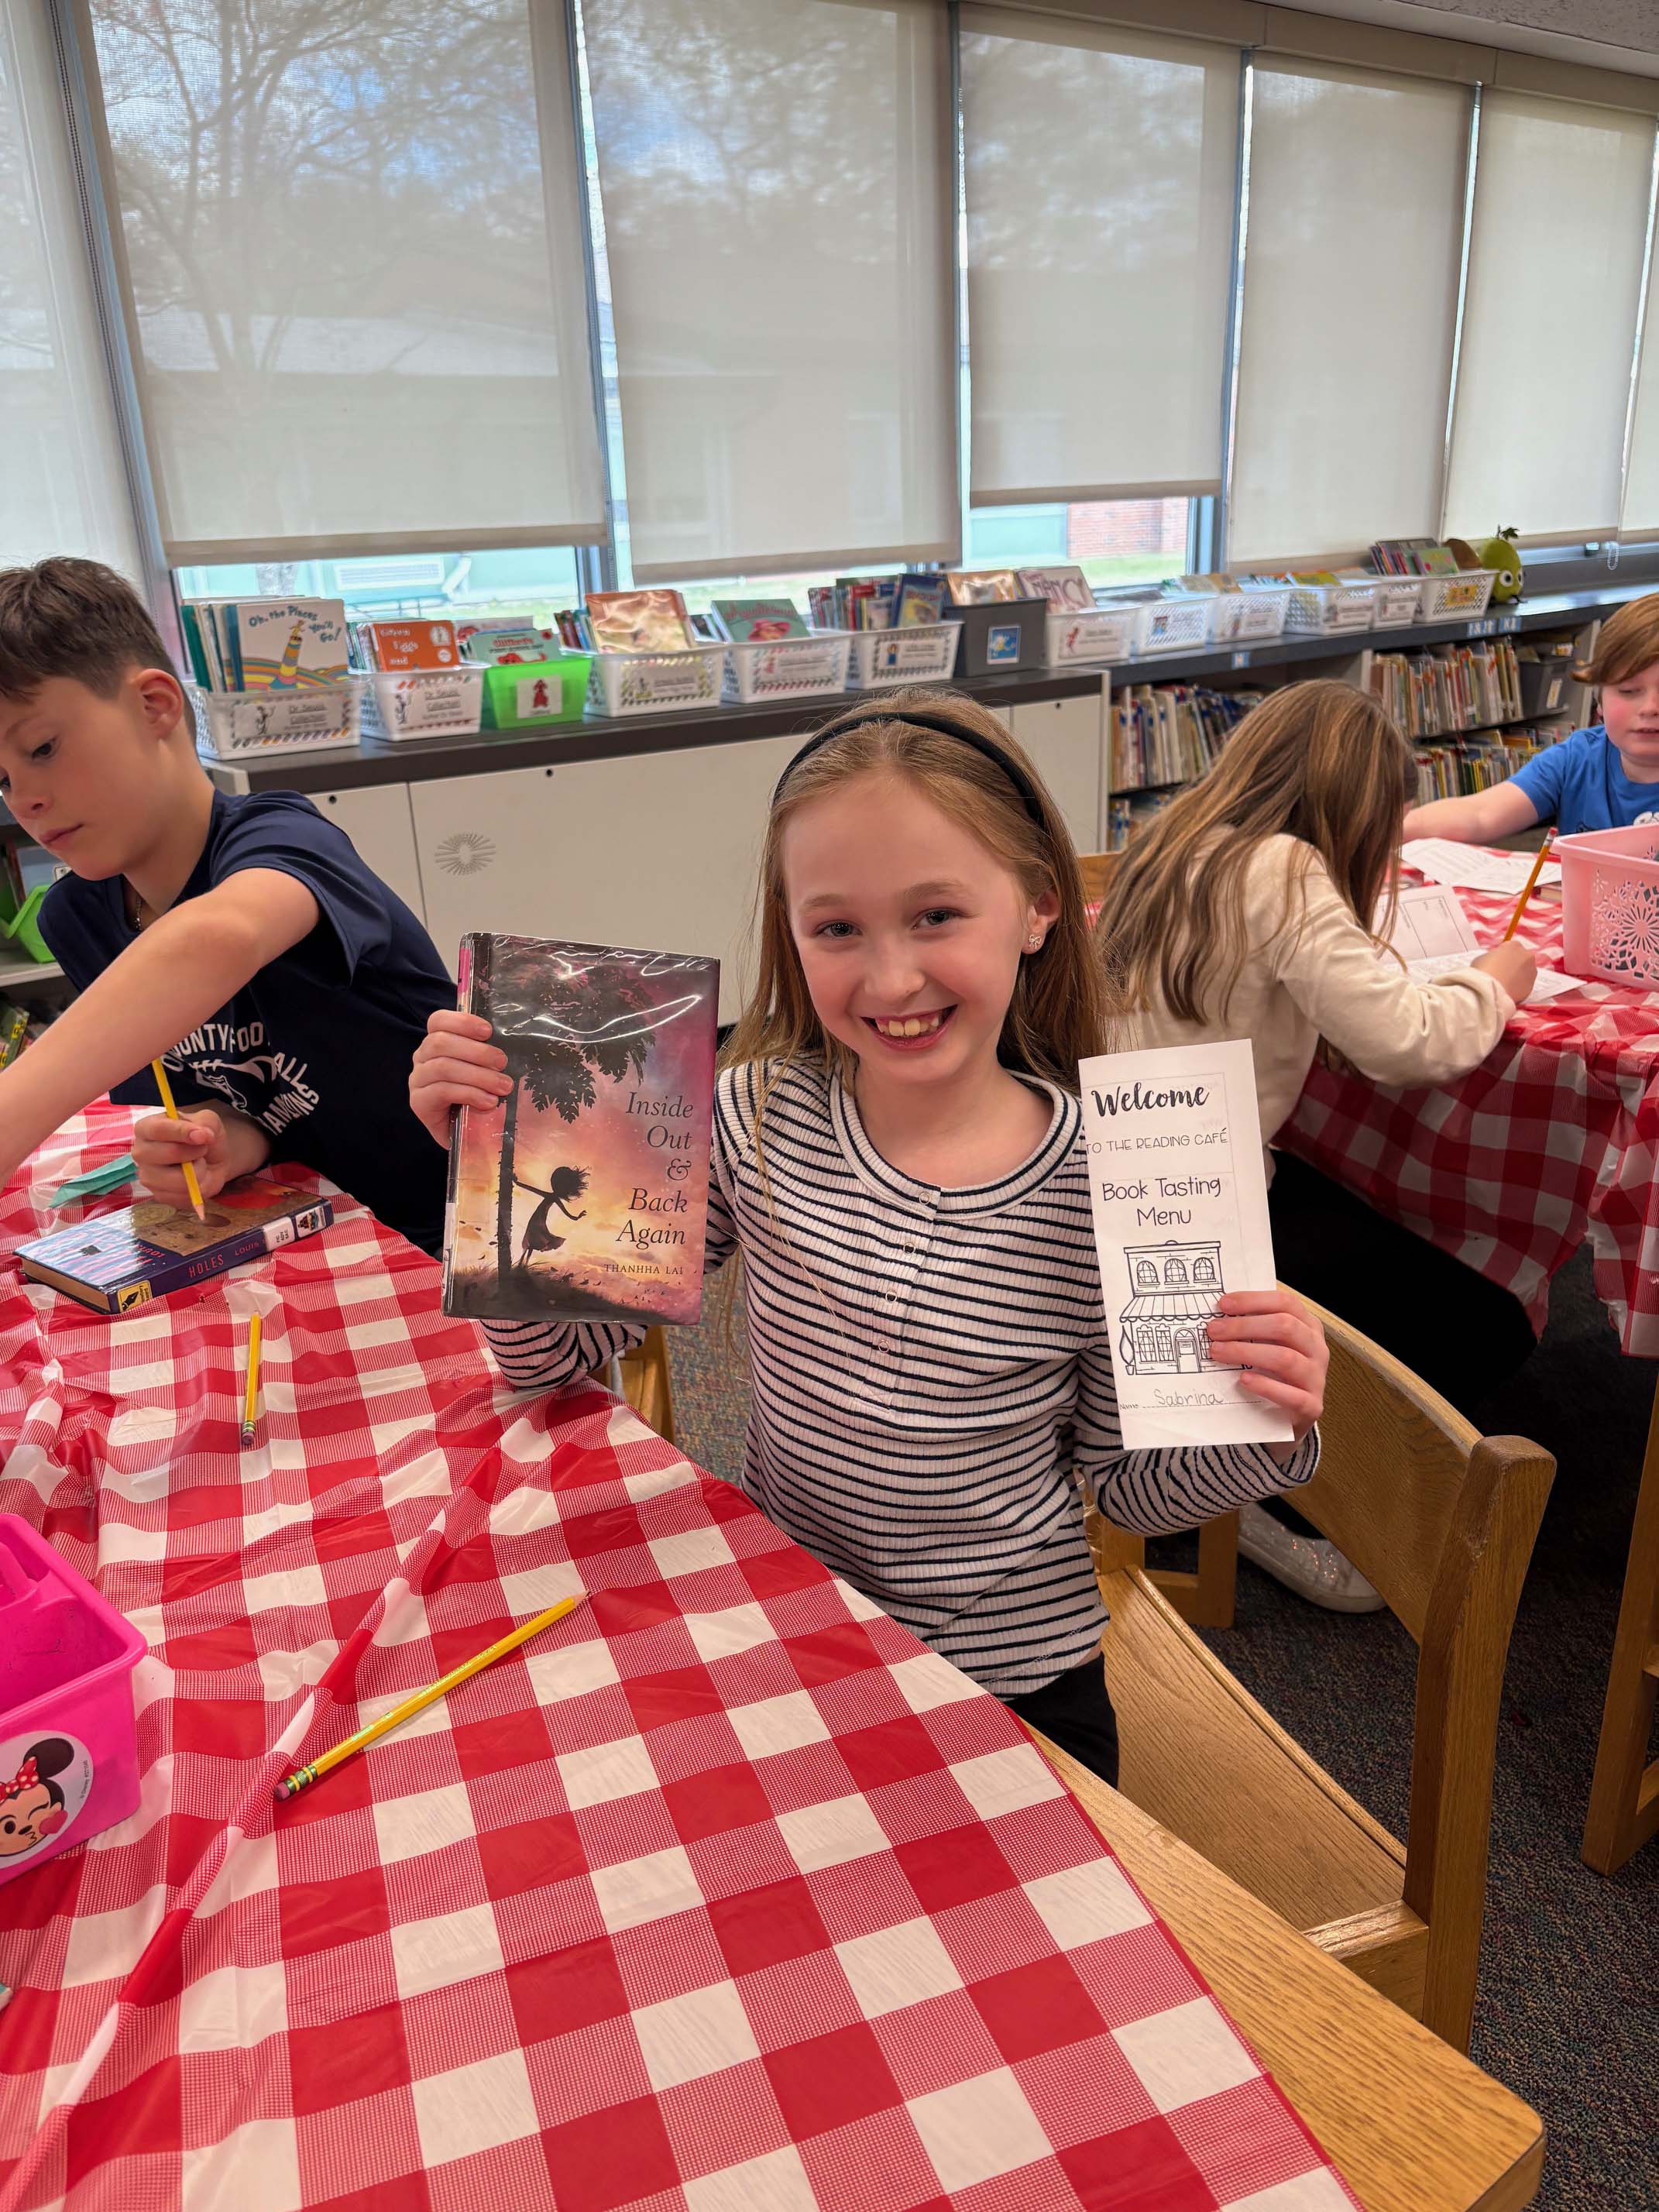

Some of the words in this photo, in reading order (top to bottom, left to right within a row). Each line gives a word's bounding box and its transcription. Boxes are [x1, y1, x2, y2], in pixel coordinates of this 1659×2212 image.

[287, 606, 318, 621] Places
[320, 627, 342, 643] Go!
[625, 1091, 694, 1118] Inside
[1091, 1082, 1210, 1117] Welcome
[647, 1125, 693, 1150] Out
[1086, 1142, 1102, 1155] TO
[1106, 1139, 1133, 1152] THE
[1136, 1135, 1190, 1149] READING
[1194, 1127, 1228, 1146] CAFÉ
[667, 1158, 692, 1181] &
[628, 1187, 688, 1214] Back
[1102, 1179, 1149, 1201] Book
[1155, 1176, 1221, 1197] Tasting
[1137, 1206, 1191, 1227] Menu
[615, 1218, 686, 1250] Again
[188, 1254, 224, 1278] HOLES
[604, 1263, 661, 1274] THANHHA
[665, 1266, 683, 1275] LAI
[1153, 1388, 1224, 1407] Sabrina
